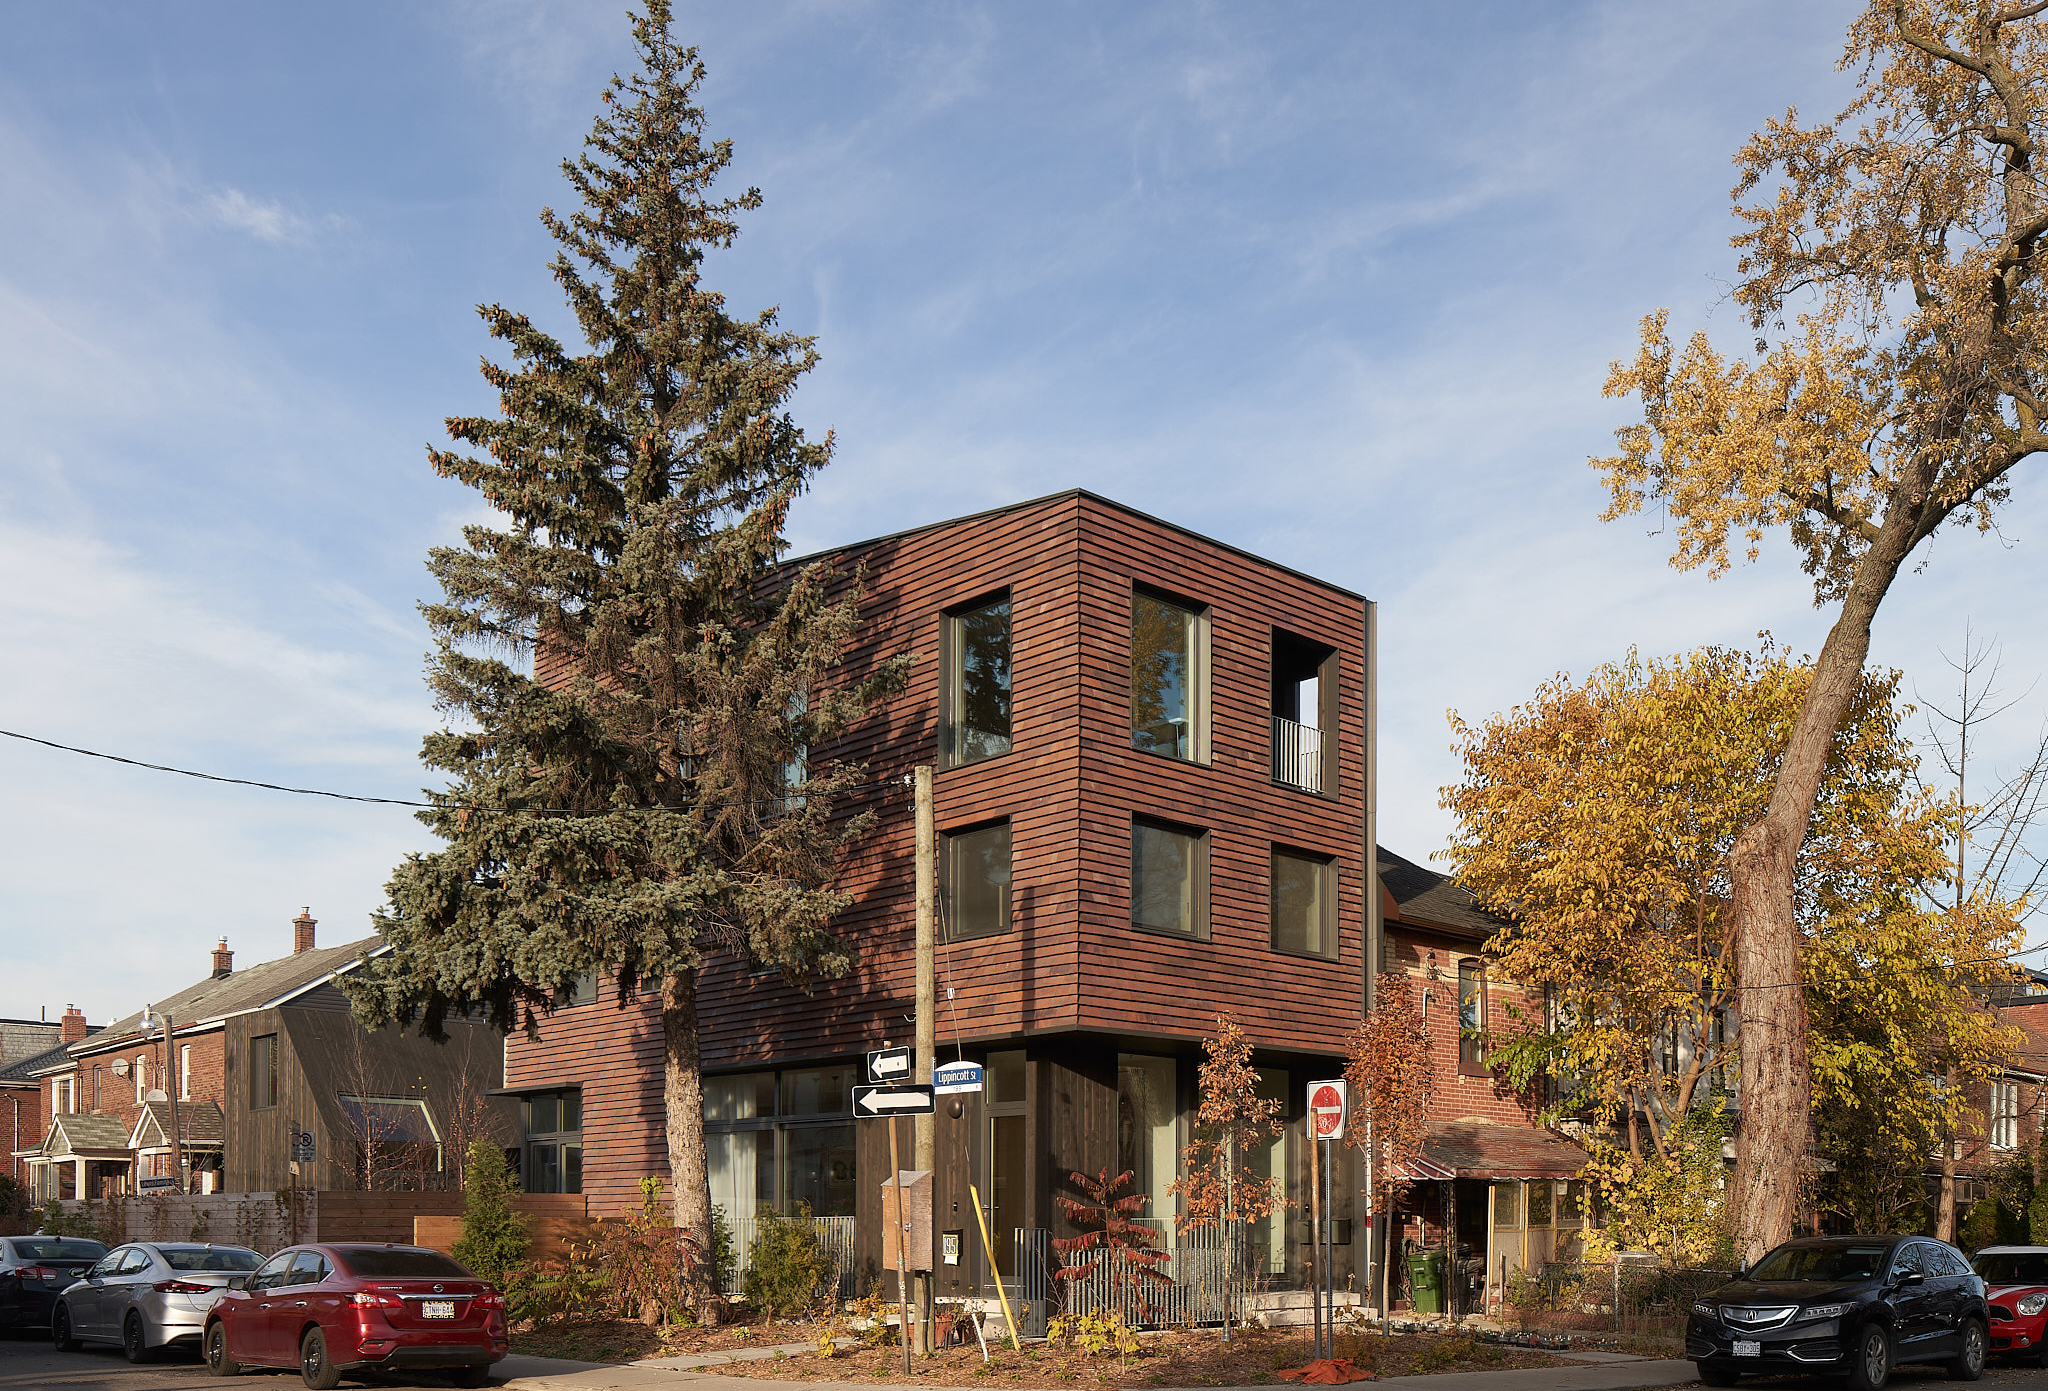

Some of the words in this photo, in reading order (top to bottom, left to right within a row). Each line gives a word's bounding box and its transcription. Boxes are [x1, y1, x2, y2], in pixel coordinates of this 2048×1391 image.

[938, 1070, 969, 1085] Lippincott
[970, 1071, 976, 1080] St
[944, 1237, 956, 1254] 195
